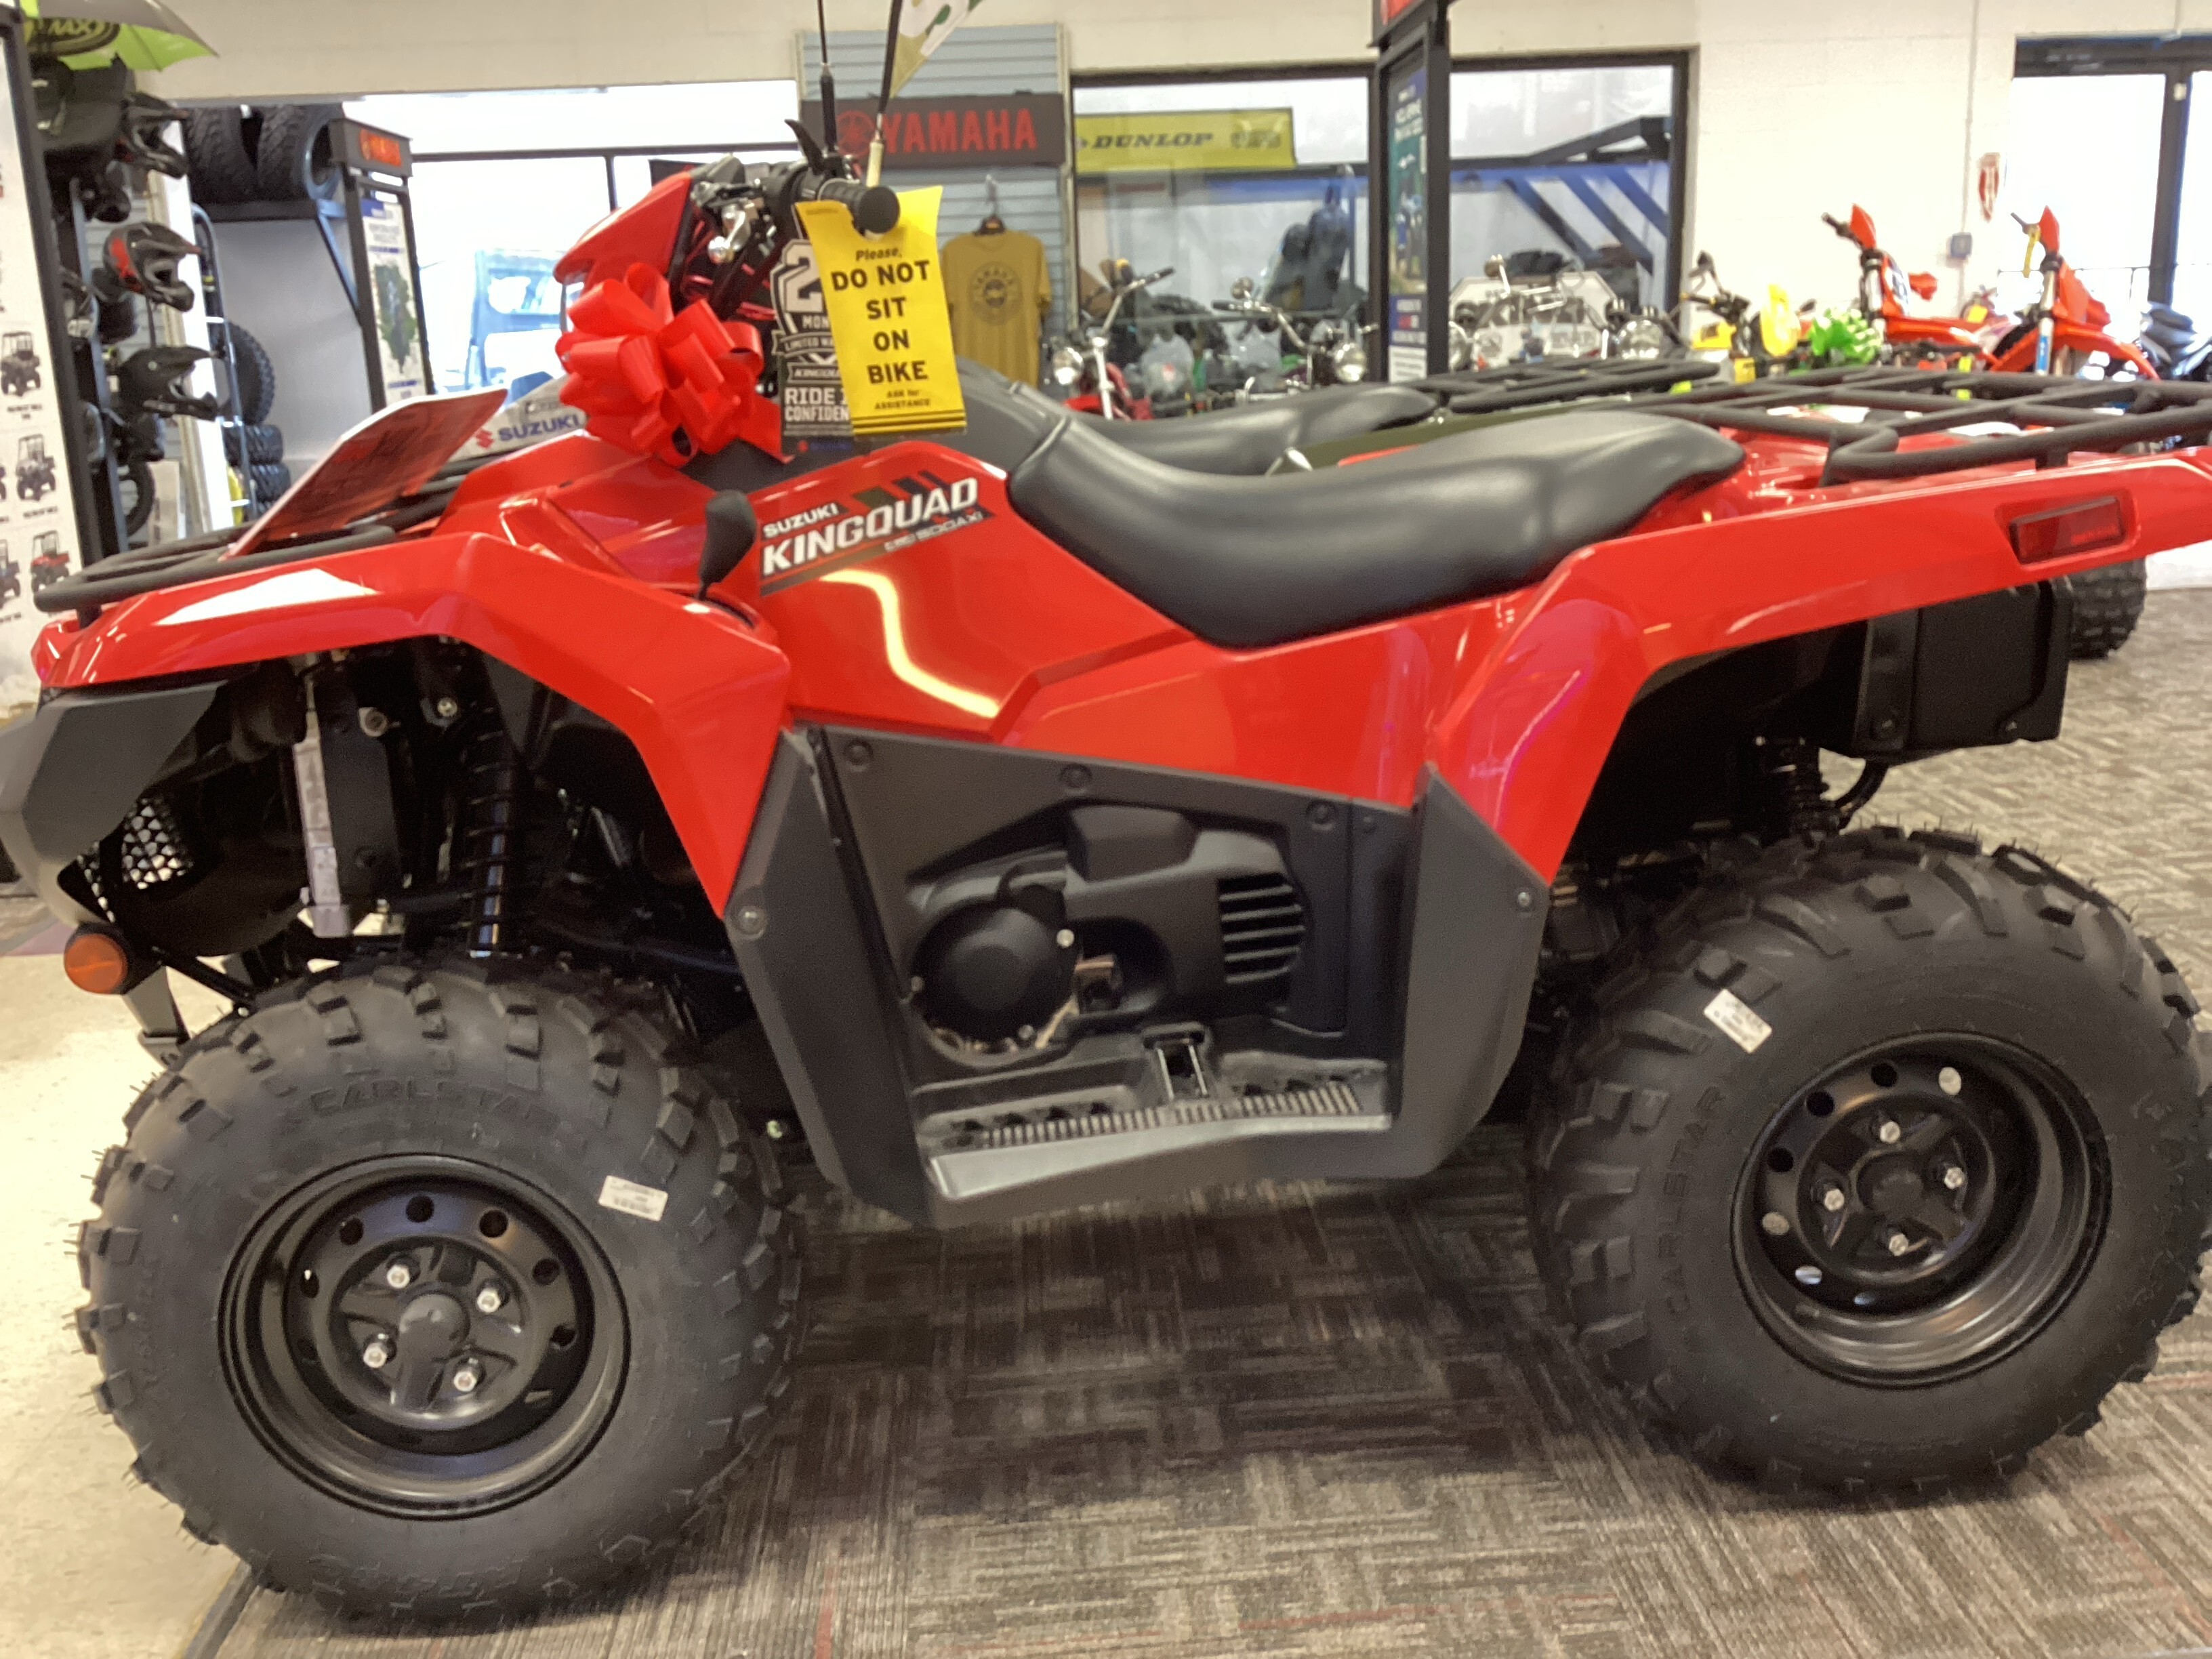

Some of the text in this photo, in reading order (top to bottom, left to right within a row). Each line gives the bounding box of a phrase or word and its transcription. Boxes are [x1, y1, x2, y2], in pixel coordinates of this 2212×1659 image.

[882, 108, 1038, 154] YAMAHA
[1091, 131, 1214, 150] DUNLOP
[855, 247, 903, 262] Please,
[831, 259, 930, 291] DO NOT
[865, 296, 907, 321] SIT
[802, 314, 830, 329] MON
[873, 328, 910, 352] ON
[867, 360, 929, 385] BIKE
[784, 387, 836, 405] RIDE
[784, 405, 850, 422] CONFIDEN
[498, 414, 581, 442] SUZUKI
[762, 501, 840, 539] SUZUKI
[762, 476, 979, 577] KINGQUAD
